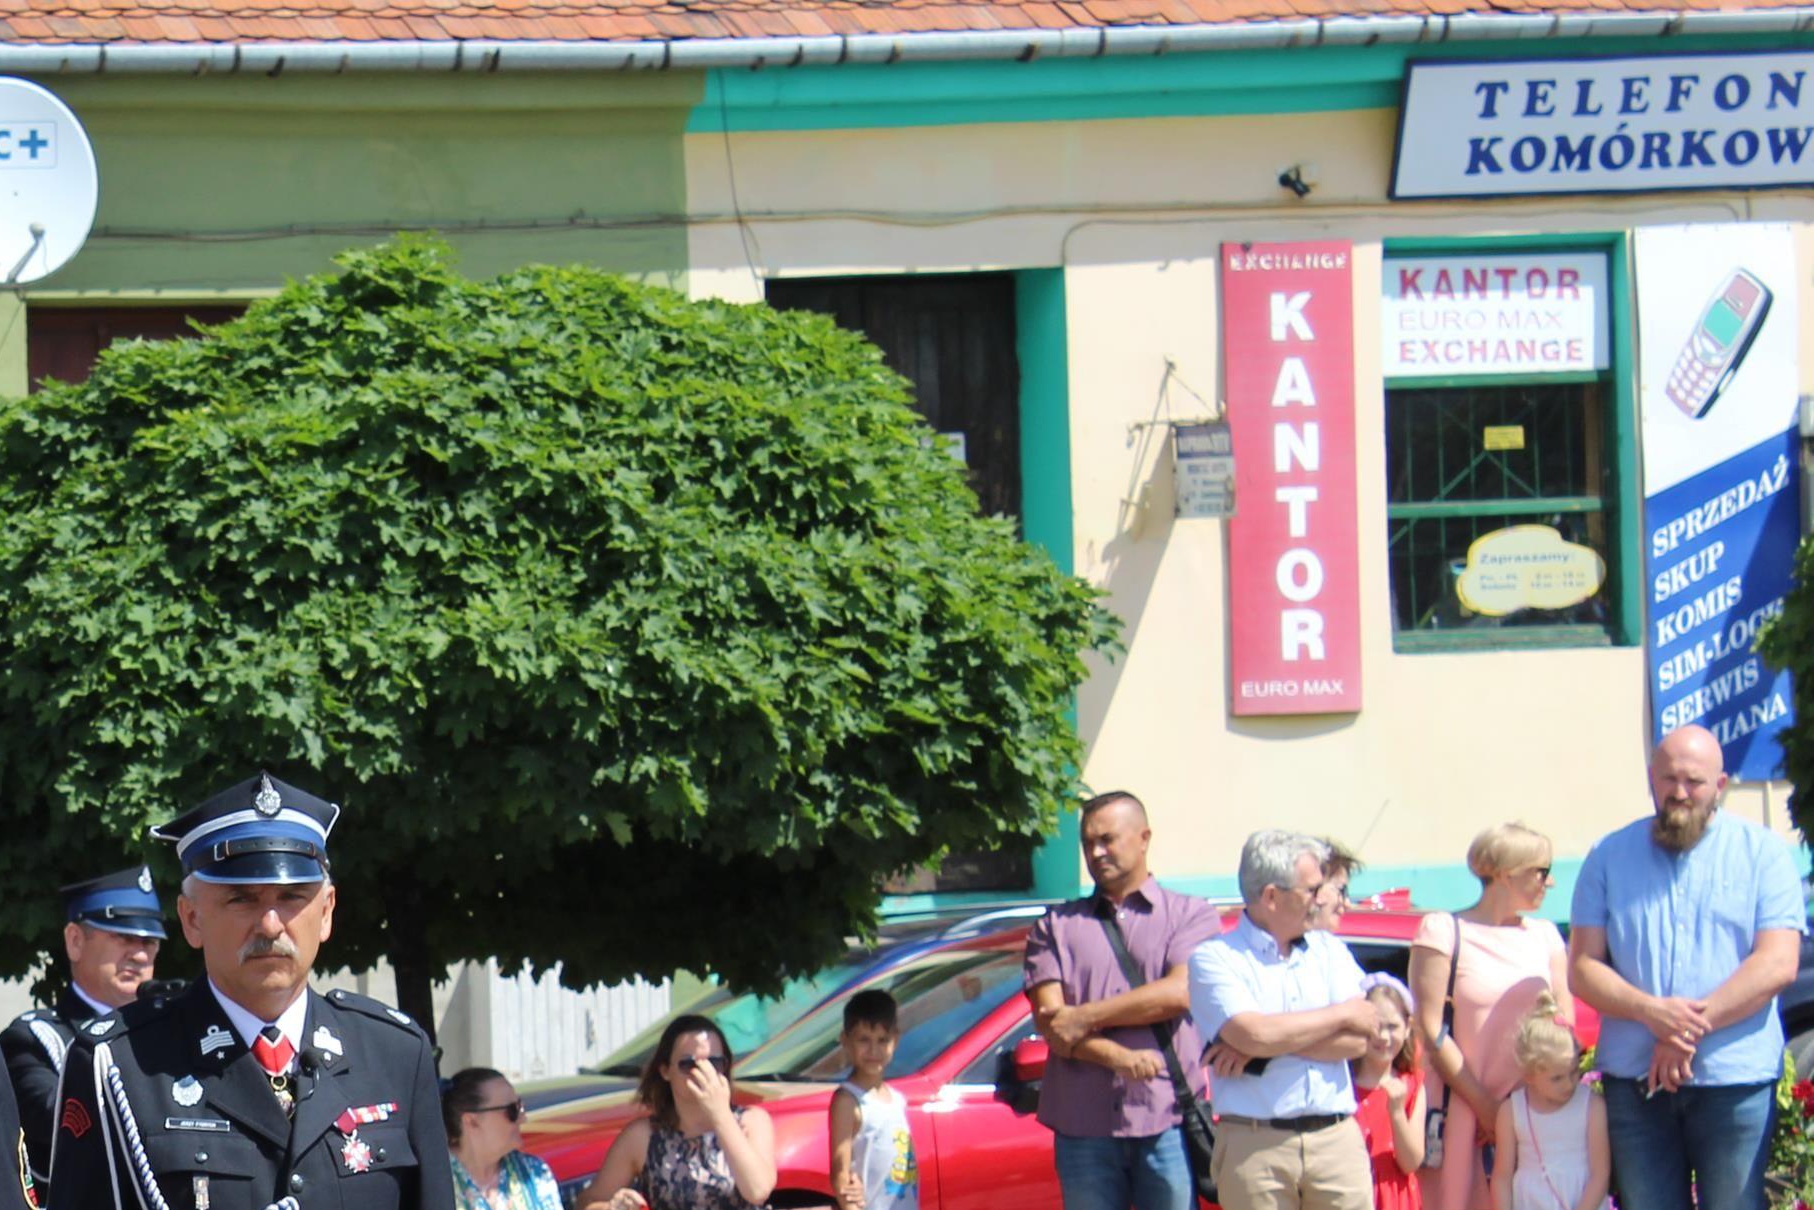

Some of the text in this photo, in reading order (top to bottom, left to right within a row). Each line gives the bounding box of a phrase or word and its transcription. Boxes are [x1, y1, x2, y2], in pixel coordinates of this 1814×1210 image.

[1475, 71, 1807, 119] TELEFON
[1464, 122, 1814, 175] KOMÓRKOW
[1398, 267, 1582, 300] KANTOR
[1398, 308, 1564, 332] EURO MAX
[1399, 338, 1584, 364] EXCHANGE
[1269, 291, 1326, 662] KANTOR
[1652, 454, 1790, 559] SPRZEDAŻ
[1654, 540, 1725, 604] SKUP
[1655, 575, 1743, 649] KOMIS
[1241, 679, 1344, 698] EURO MAX
[1660, 658, 1760, 738] SERWIS
